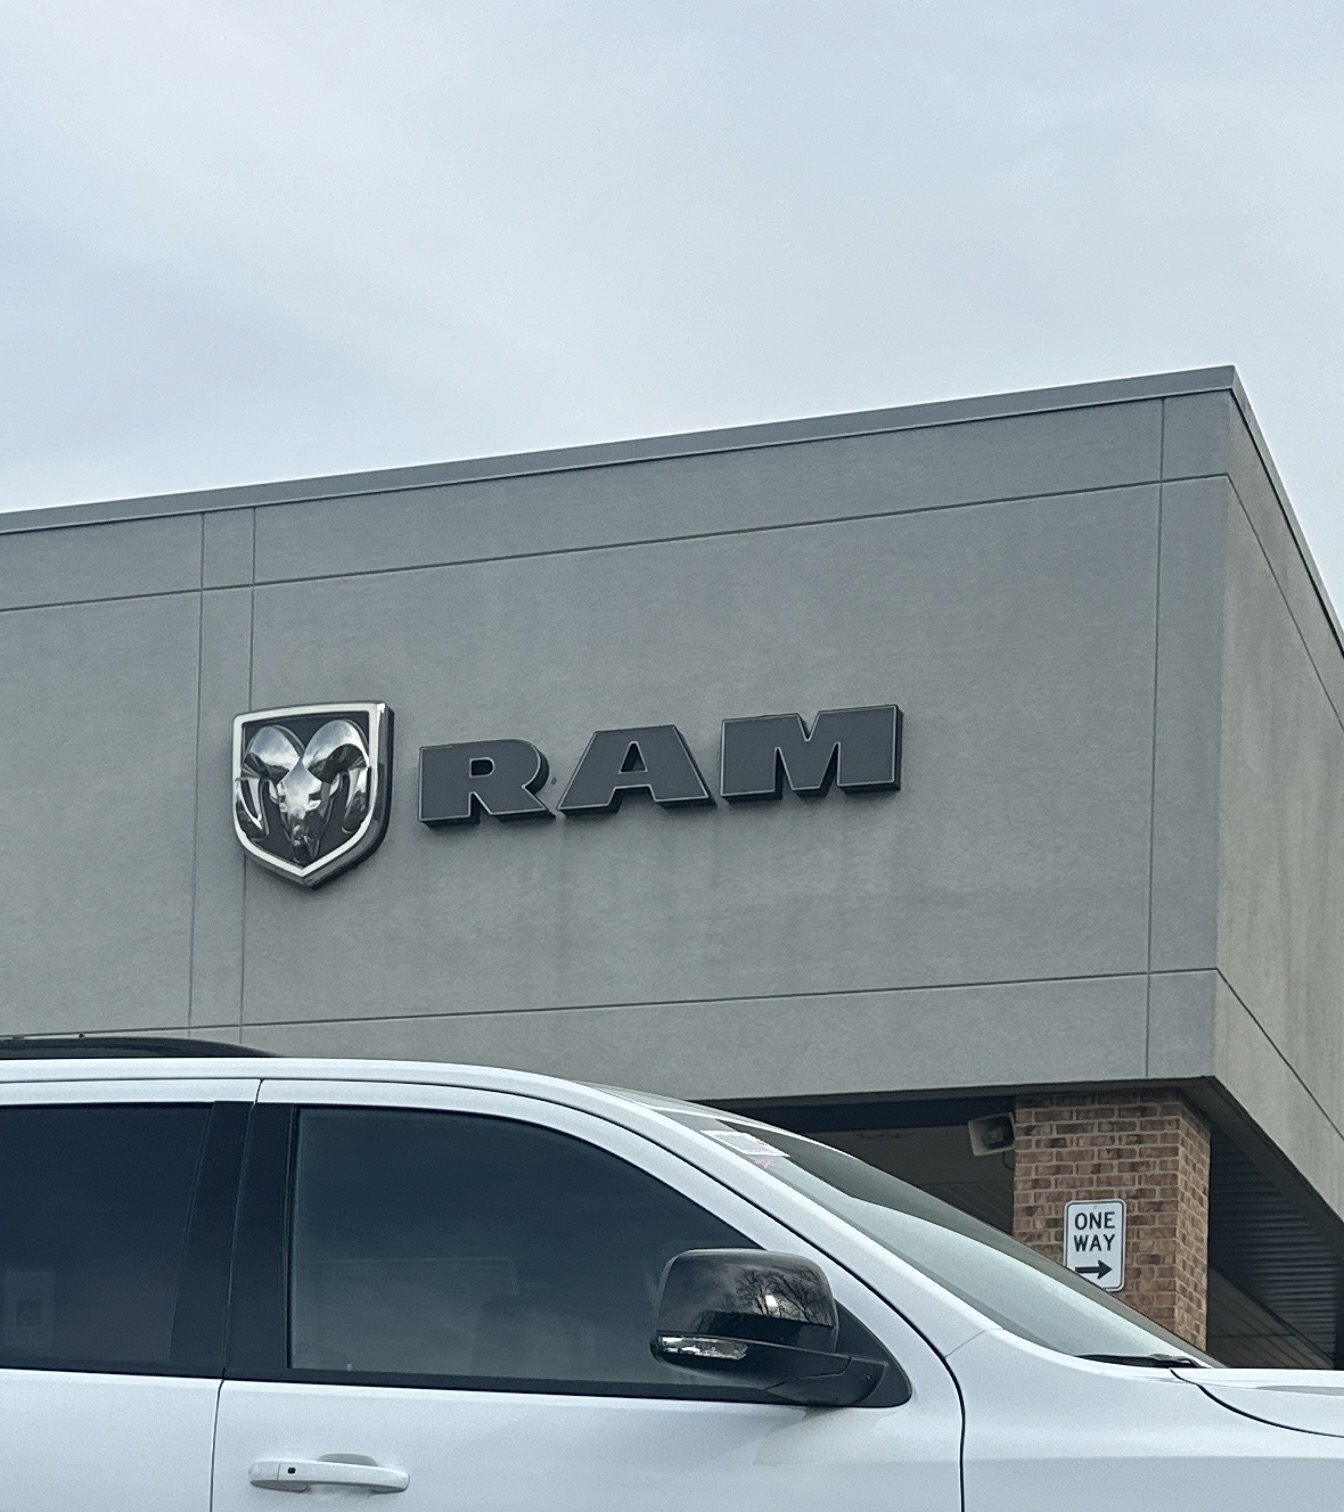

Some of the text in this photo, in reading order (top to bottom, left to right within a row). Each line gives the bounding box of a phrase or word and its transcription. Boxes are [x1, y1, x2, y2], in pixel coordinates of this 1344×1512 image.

[418, 704, 901, 824] RAM
[1074, 1211, 1116, 1230] ONE
[1073, 1233, 1116, 1252] WAY
